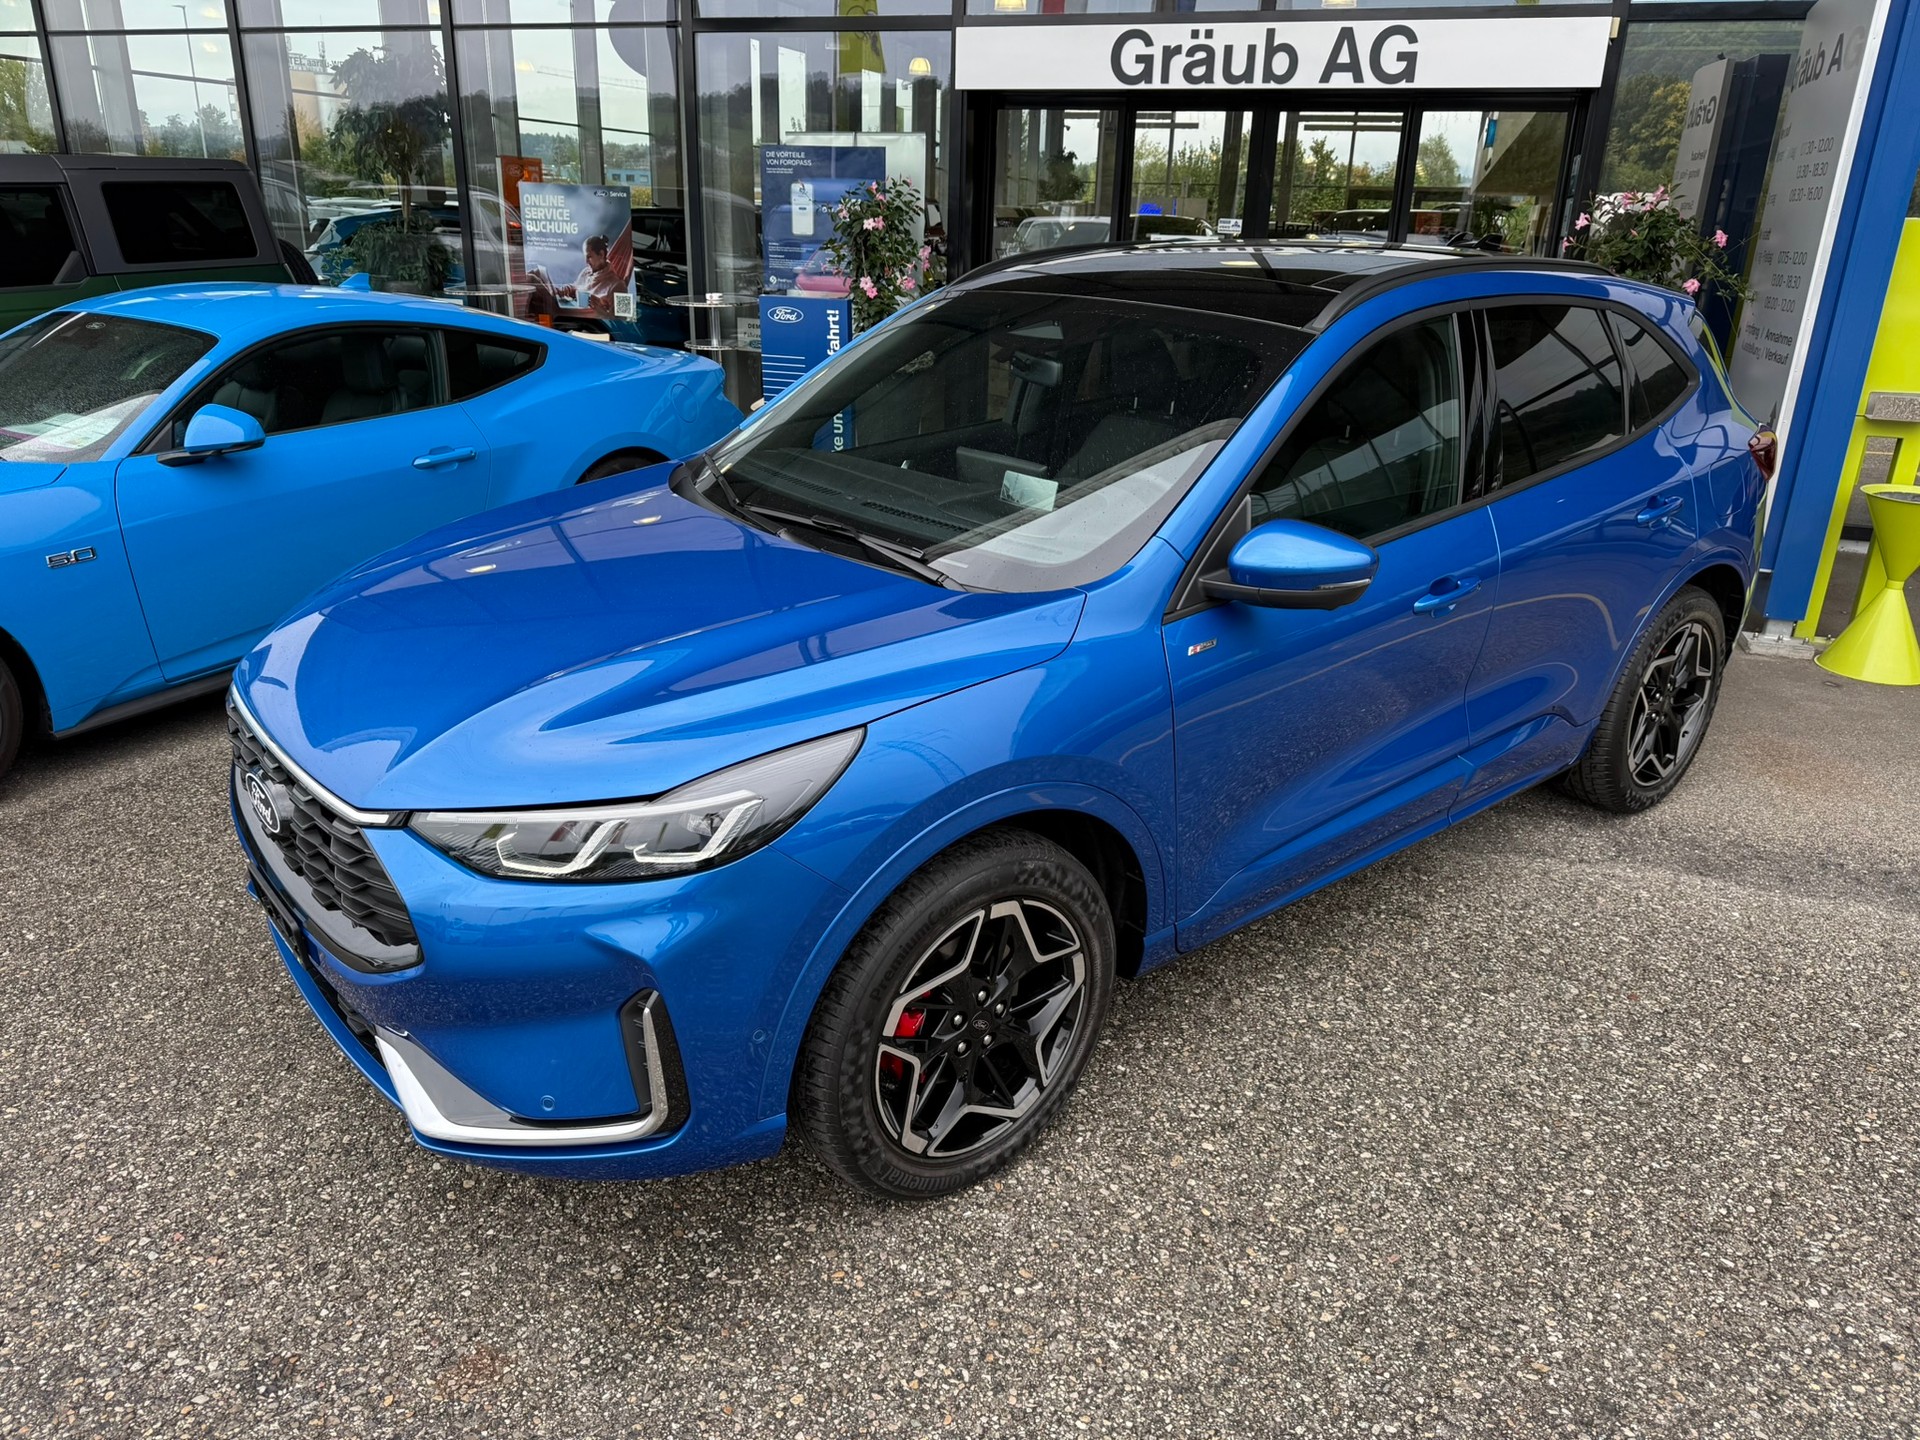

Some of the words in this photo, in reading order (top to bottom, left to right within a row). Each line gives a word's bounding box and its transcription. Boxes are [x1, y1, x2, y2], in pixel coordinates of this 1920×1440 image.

[1110, 28, 1298, 86] Gräub
[1318, 24, 1419, 85] AG
[524, 193, 565, 206] ONLINE
[525, 208, 570, 221] SERVICE
[527, 220, 578, 234] BUCHUNG
[1276, 221, 1338, 235] Herzlich
[771, 306, 800, 322] Ford
[1765, 328, 1793, 346] Annahme
[1765, 346, 1790, 366] Verkauf
[250, 779, 275, 828] Ford
